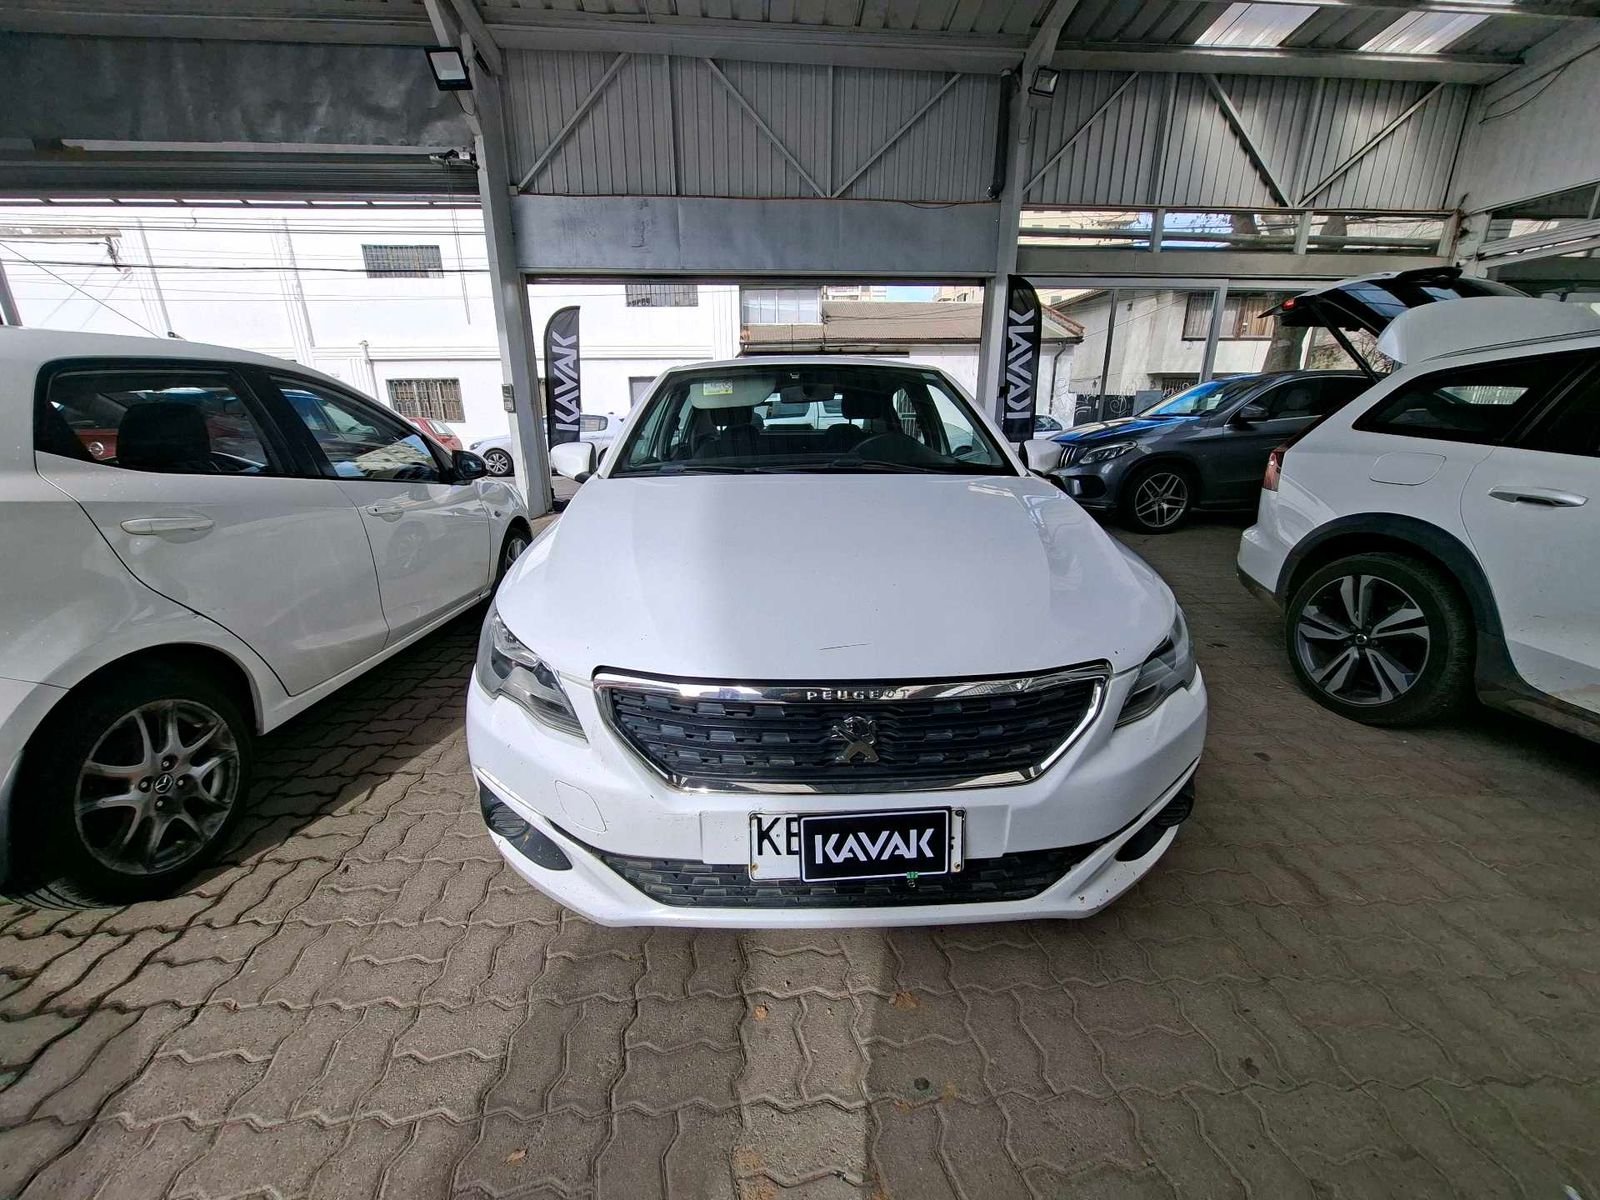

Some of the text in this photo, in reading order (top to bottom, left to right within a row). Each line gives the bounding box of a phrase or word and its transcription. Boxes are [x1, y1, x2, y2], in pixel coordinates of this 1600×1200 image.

[551, 330, 580, 432] KAVAK
[806, 689, 910, 701] PEUGEOT
[814, 828, 935, 864] KAVAK
